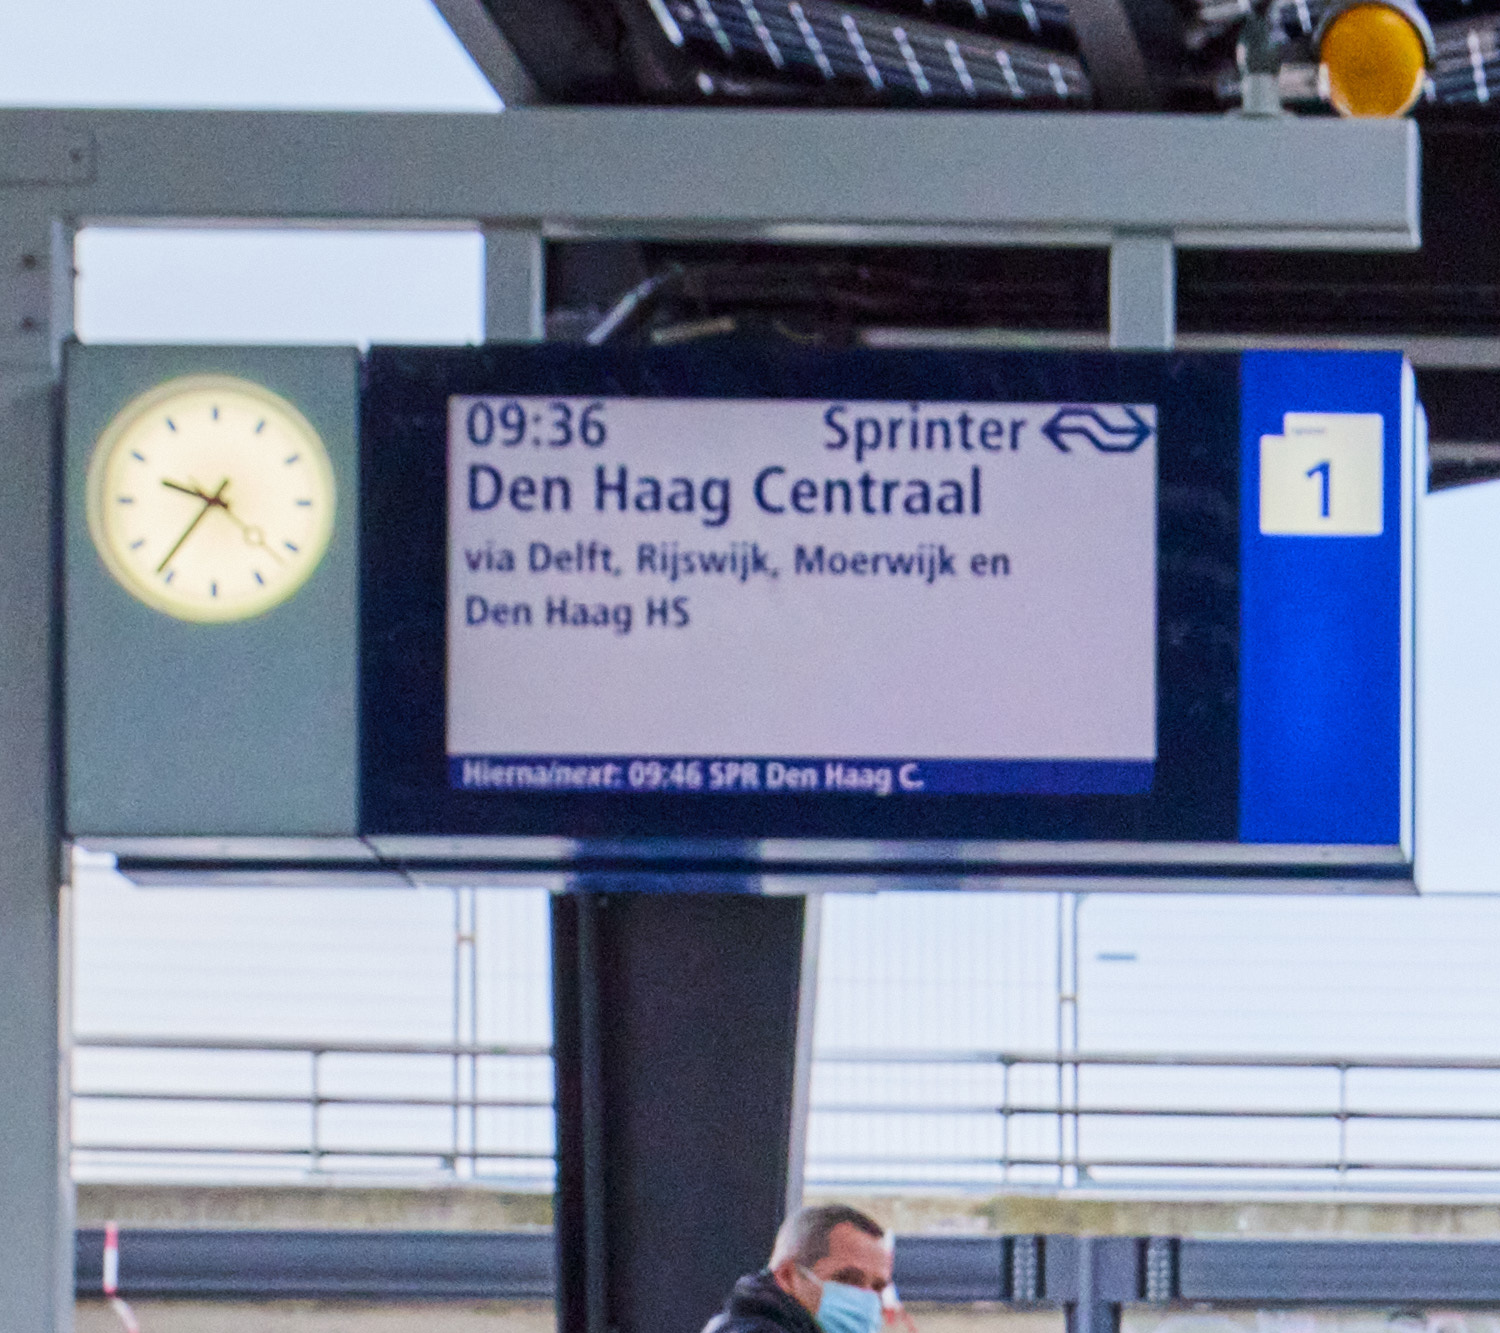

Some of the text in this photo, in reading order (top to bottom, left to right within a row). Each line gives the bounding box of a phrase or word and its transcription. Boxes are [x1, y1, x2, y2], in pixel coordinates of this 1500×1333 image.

[466, 401, 1028, 463] 09:36 Sprinter
[467, 463, 981, 528] Den Haag Centraal
[1306, 460, 1331, 518] 1
[465, 540, 1012, 584] via Delft, Rijswijk, Moerwijk en
[465, 594, 690, 636] Den Haag HS
[627, 760, 702, 789] 09:46
[708, 761, 759, 789] SPR
[765, 761, 819, 789] Den
[824, 762, 893, 796] Haag
